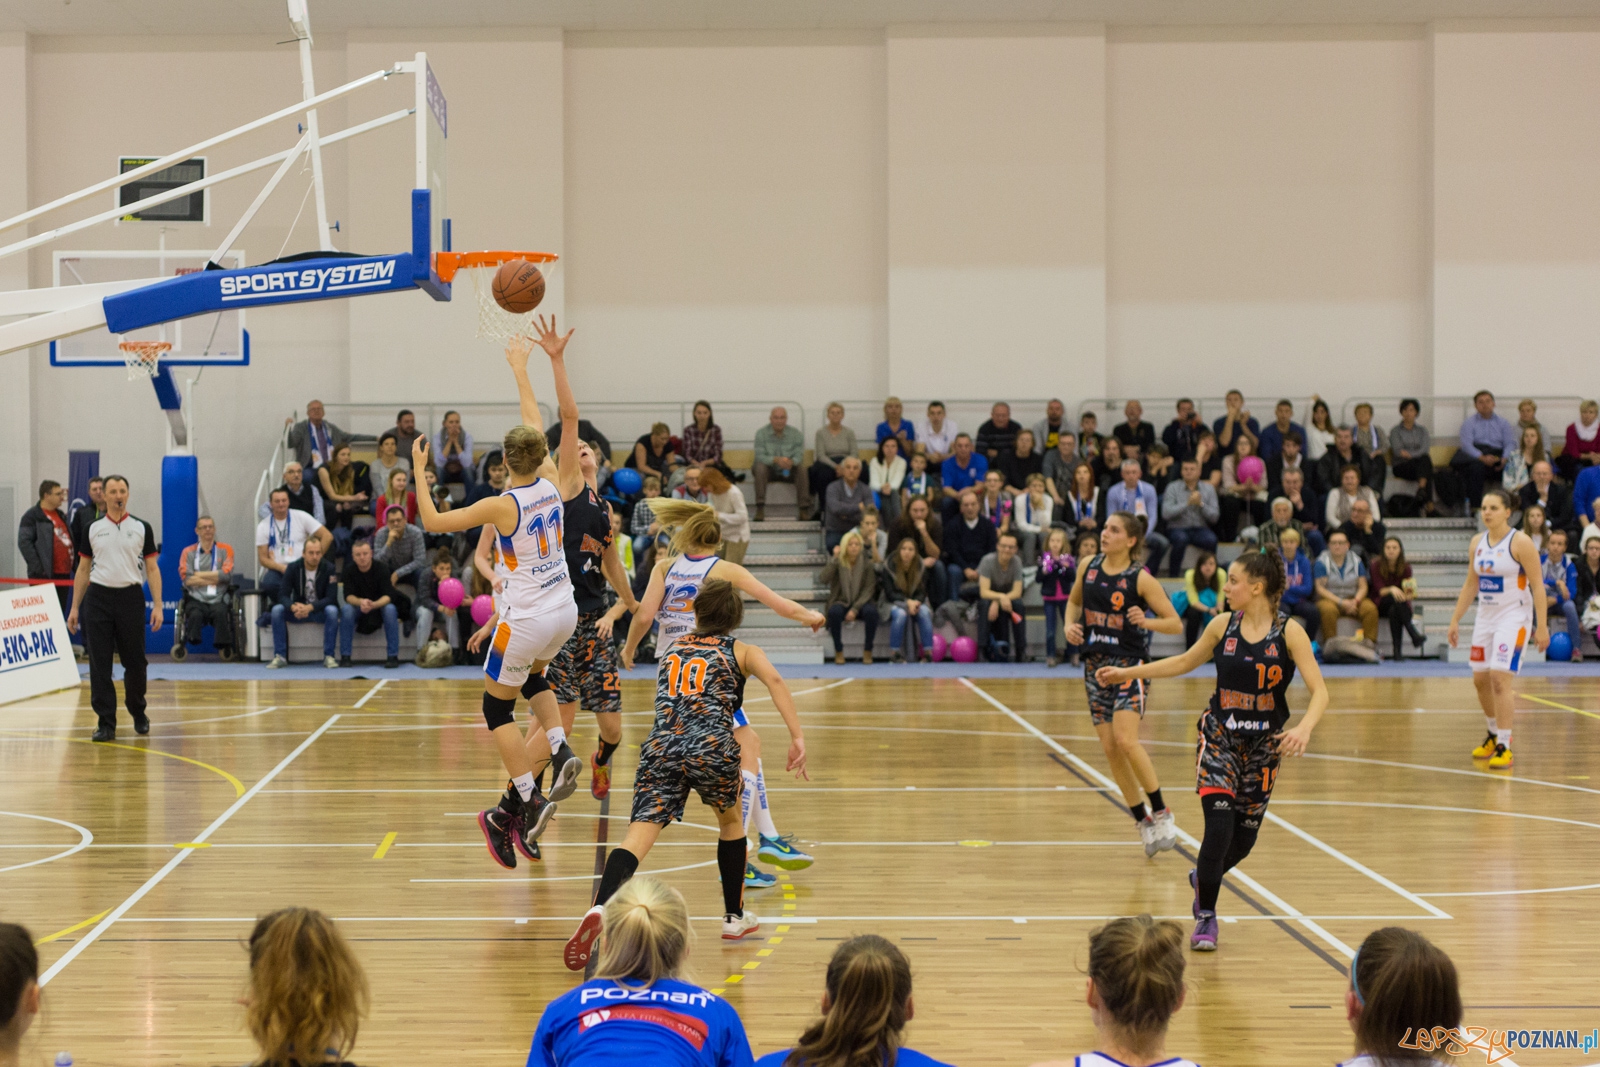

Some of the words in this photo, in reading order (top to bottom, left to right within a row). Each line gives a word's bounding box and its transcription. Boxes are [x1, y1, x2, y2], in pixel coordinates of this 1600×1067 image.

[220, 260, 396, 295] SPORTSYSTEM
[526, 506, 563, 560] 11
[11, 594, 45, 610] DRUKARNIA
[1110, 591, 1125, 612] 9
[0, 612, 50, 632] LEKSOGRAFICZNA
[664, 625, 688, 635] AGROBEX
[667, 653, 709, 697] 10
[1255, 663, 1283, 690] 19
[677, 1022, 704, 1042] STARS
